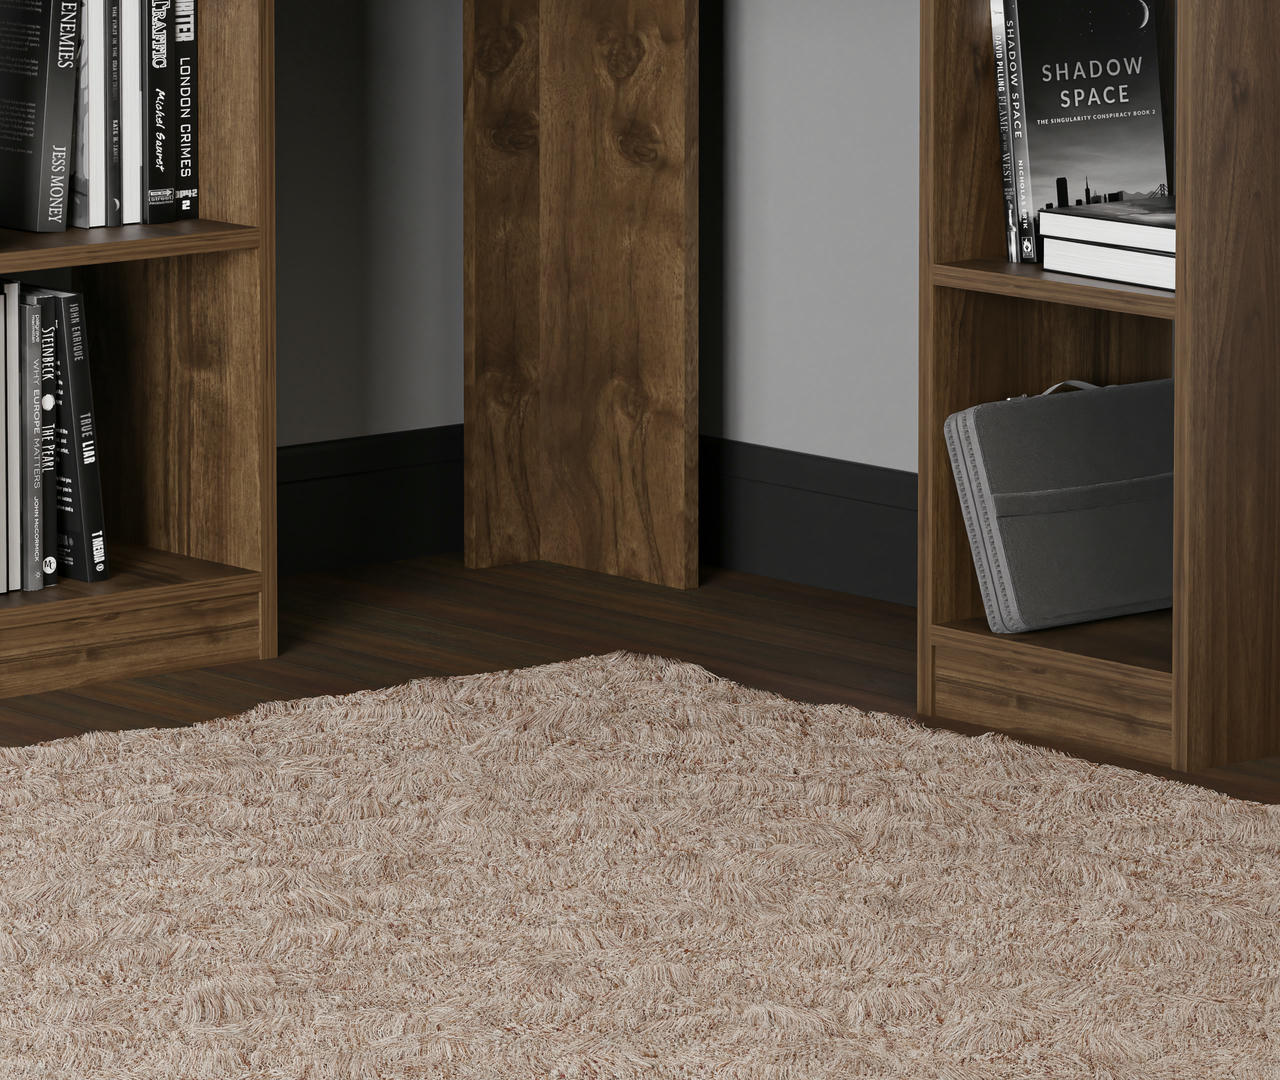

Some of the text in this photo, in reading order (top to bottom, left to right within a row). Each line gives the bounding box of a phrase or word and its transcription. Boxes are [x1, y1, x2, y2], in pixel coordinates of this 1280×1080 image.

[57, 2, 78, 68] ENEMIES
[995, 35, 1005, 92] DAVID PILLING
[1006, 20, 1022, 139] SHADOW SPACE
[1042, 56, 1143, 82] SHADOW
[180, 57, 191, 177] LONDON CRIMES
[998, 95, 1009, 133] FLAME
[1050, 115, 1091, 124] SINGULARITY
[1093, 111, 1131, 120] CONSPIRACY
[1133, 109, 1150, 117] BOOK
[1060, 84, 1129, 108] SPACE
[48, 145, 67, 223] JESS MONEY
[1002, 152, 1012, 183] WEST
[1018, 160, 1026, 206] NICHOLAS
[41, 326, 56, 381] STEINBECK
[69, 303, 84, 362] JOHN ENRIQUE
[41, 423, 55, 473] THE PEARL
[80, 412, 96, 465] TRUE LIAR
[92, 536, 106, 564] MEDIA
